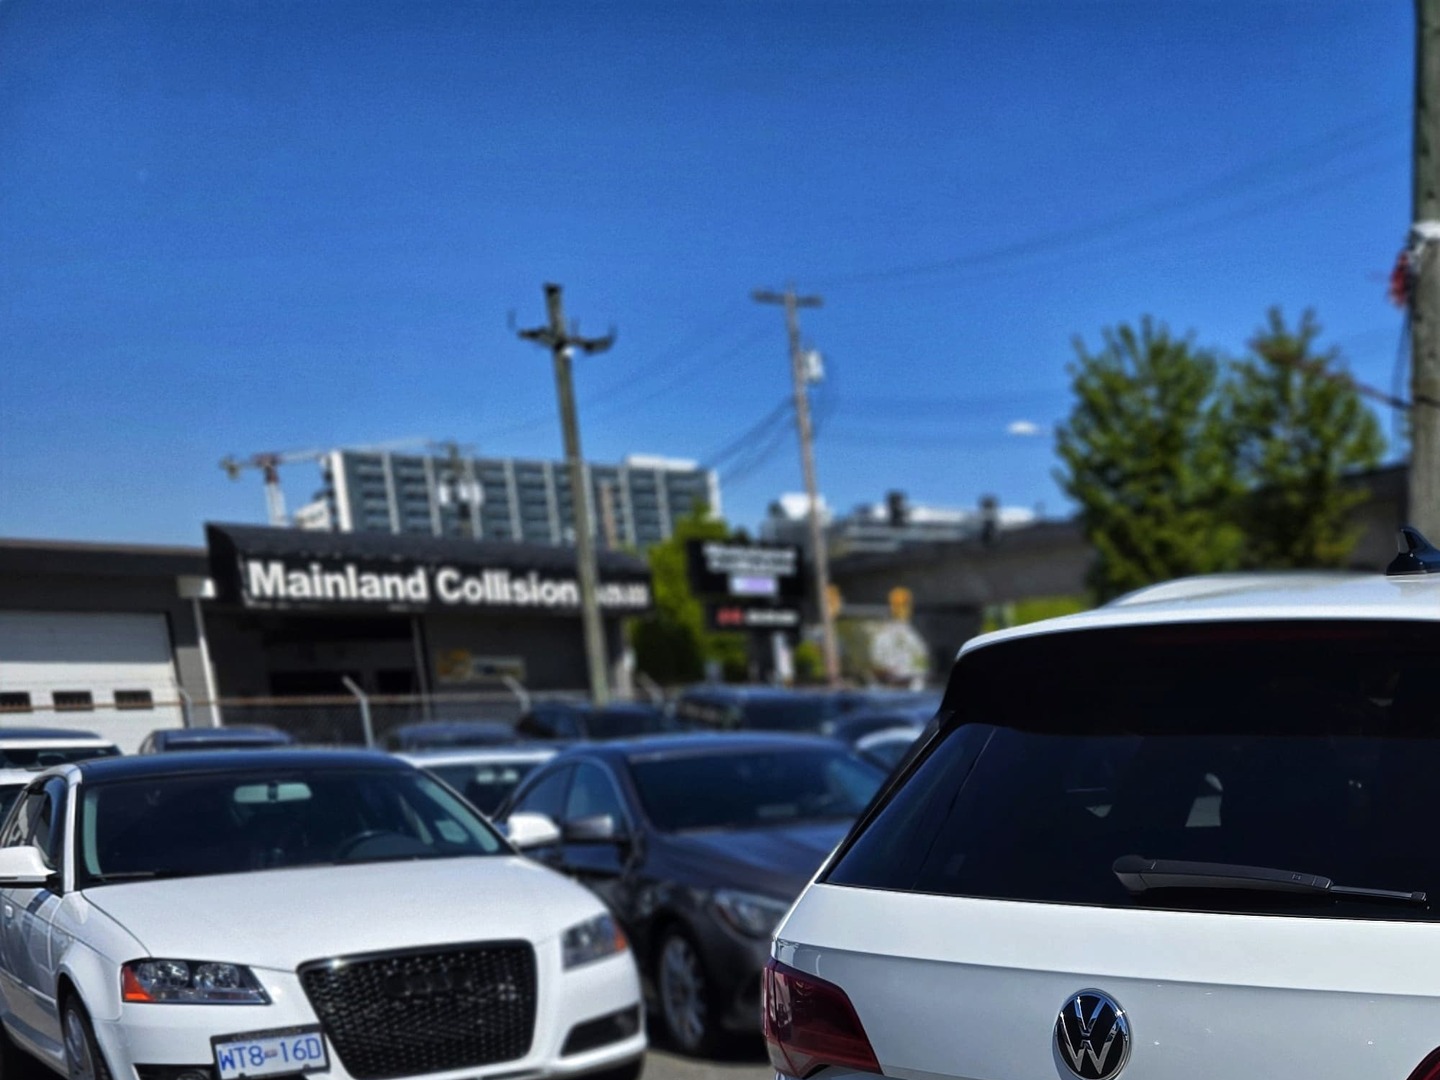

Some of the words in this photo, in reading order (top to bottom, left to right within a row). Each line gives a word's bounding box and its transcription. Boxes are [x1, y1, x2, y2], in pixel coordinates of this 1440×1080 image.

[247, 561, 429, 600] Mainland
[437, 568, 579, 606] Collision
[218, 1045, 265, 1070] WT8
